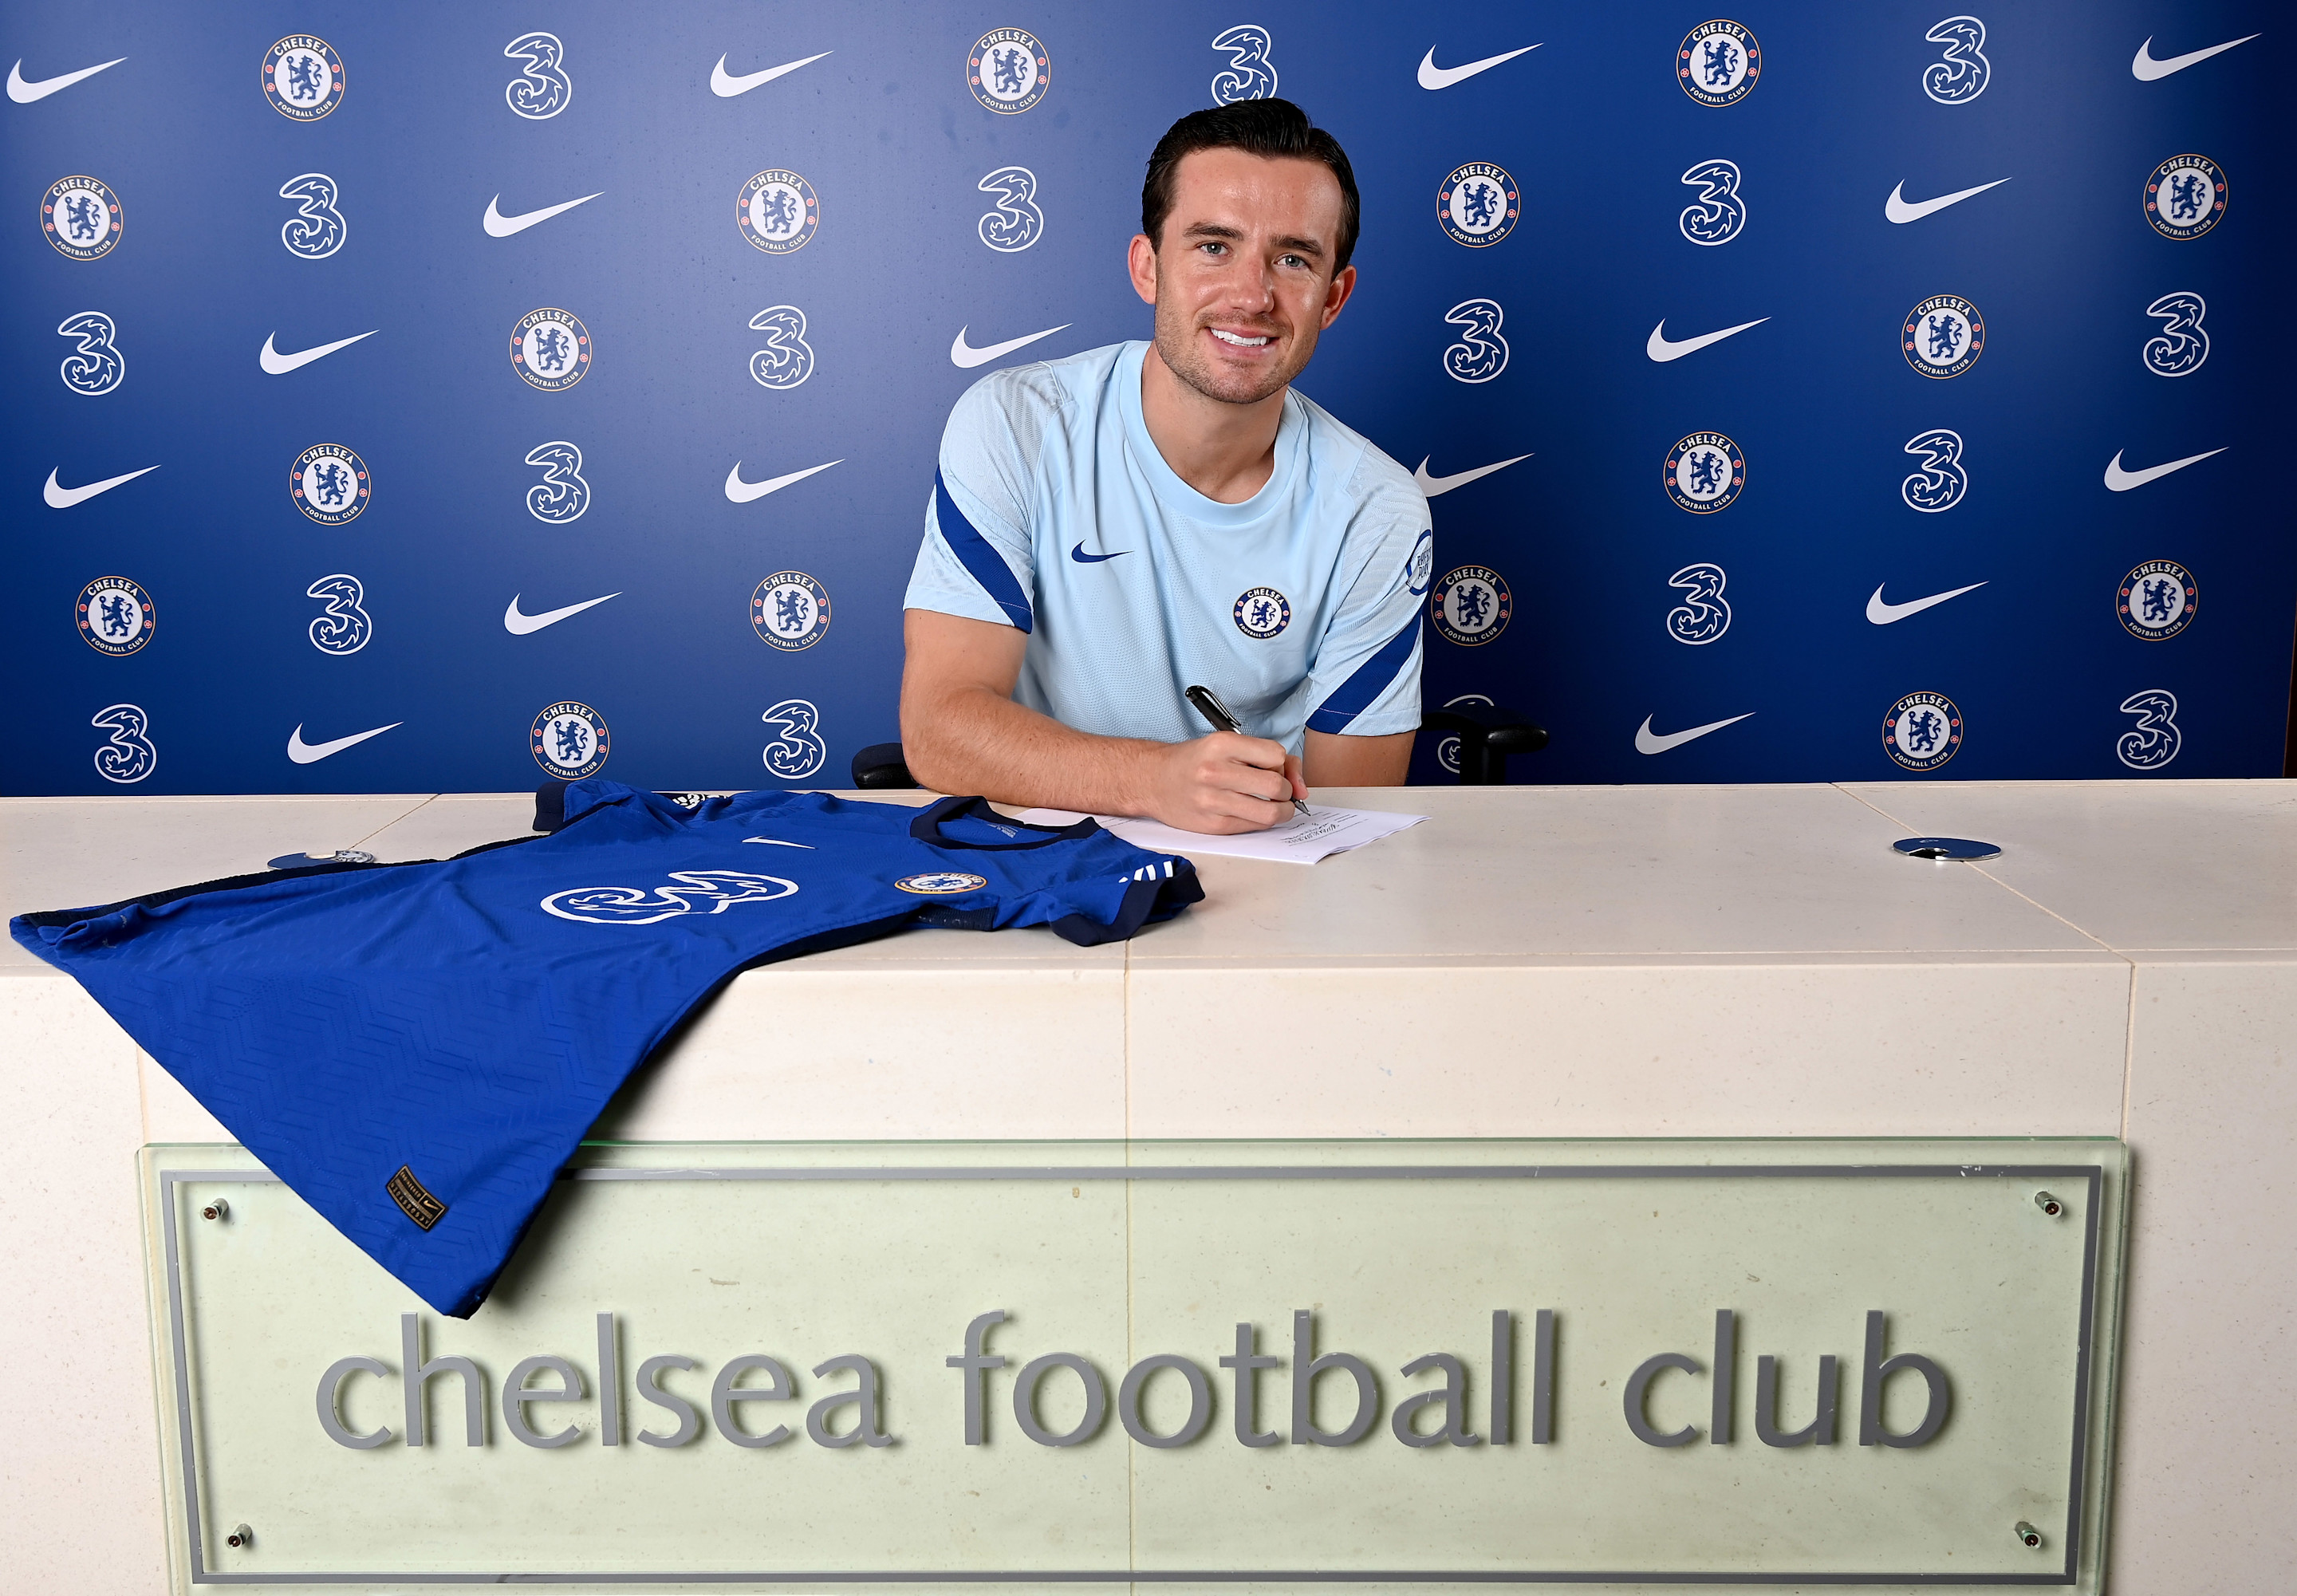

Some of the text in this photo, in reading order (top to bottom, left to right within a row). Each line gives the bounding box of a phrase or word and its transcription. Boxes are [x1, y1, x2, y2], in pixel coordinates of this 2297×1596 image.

[981, 31, 1034, 49] CHELSEA
[1692, 23, 1745, 41] CHELSEA
[274, 37, 327, 56] CHELSEA
[982, 93, 1036, 109] FOOTBALL CLUB
[1690, 86, 1745, 102] FOOTBALL CLUB
[278, 100, 332, 116] FOOTBALL CLUB
[1452, 165, 1504, 183] CHELSEA
[2161, 157, 2214, 175] CHELSEA
[53, 179, 105, 197] CHELSEA
[750, 172, 802, 191] CHELSEA
[1451, 227, 1504, 243] FOOTBALL CLUB
[2156, 219, 2212, 235] FOOTBALL CLUB
[57, 240, 110, 256] FOOTBALL CLUB
[751, 234, 806, 250] FOOTBALL CLUB
[1917, 298, 1970, 316] CHELSEA
[522, 311, 574, 329] CHELSEA
[1914, 359, 1969, 375] FOOTBALL CLUB
[526, 371, 579, 387] FOOTBALL CLUB
[1679, 435, 1731, 451] CHELSEA
[302, 447, 353, 463] CHELSEA
[1676, 494, 1730, 509] FOOTBALL CLUB
[305, 506, 358, 521] FOOTBALL CLUB
[1446, 569, 1496, 585] CHELSEA
[2133, 563, 2184, 580] CHELSEA
[88, 579, 138, 596] CHELSEA
[764, 574, 814, 591] CHELSEA
[1247, 589, 1285, 605] CHELSEA
[1239, 623, 1262, 637] FOOTBALL
[1445, 627, 1497, 641] FOOTBALL CLUB
[2129, 622, 2182, 636] FOOTBALL CLUB
[91, 637, 143, 652] FOOTBALL CLUB
[765, 632, 817, 647] FOOTBALL CLUB
[1897, 695, 1948, 711] CHELSEA
[542, 704, 593, 721] CHELSEA
[1895, 752, 1948, 766] FOOTBALL CLUB
[546, 762, 597, 776] FOOTBALL CLUB
[317, 1309, 1952, 1449] chelsea football club
